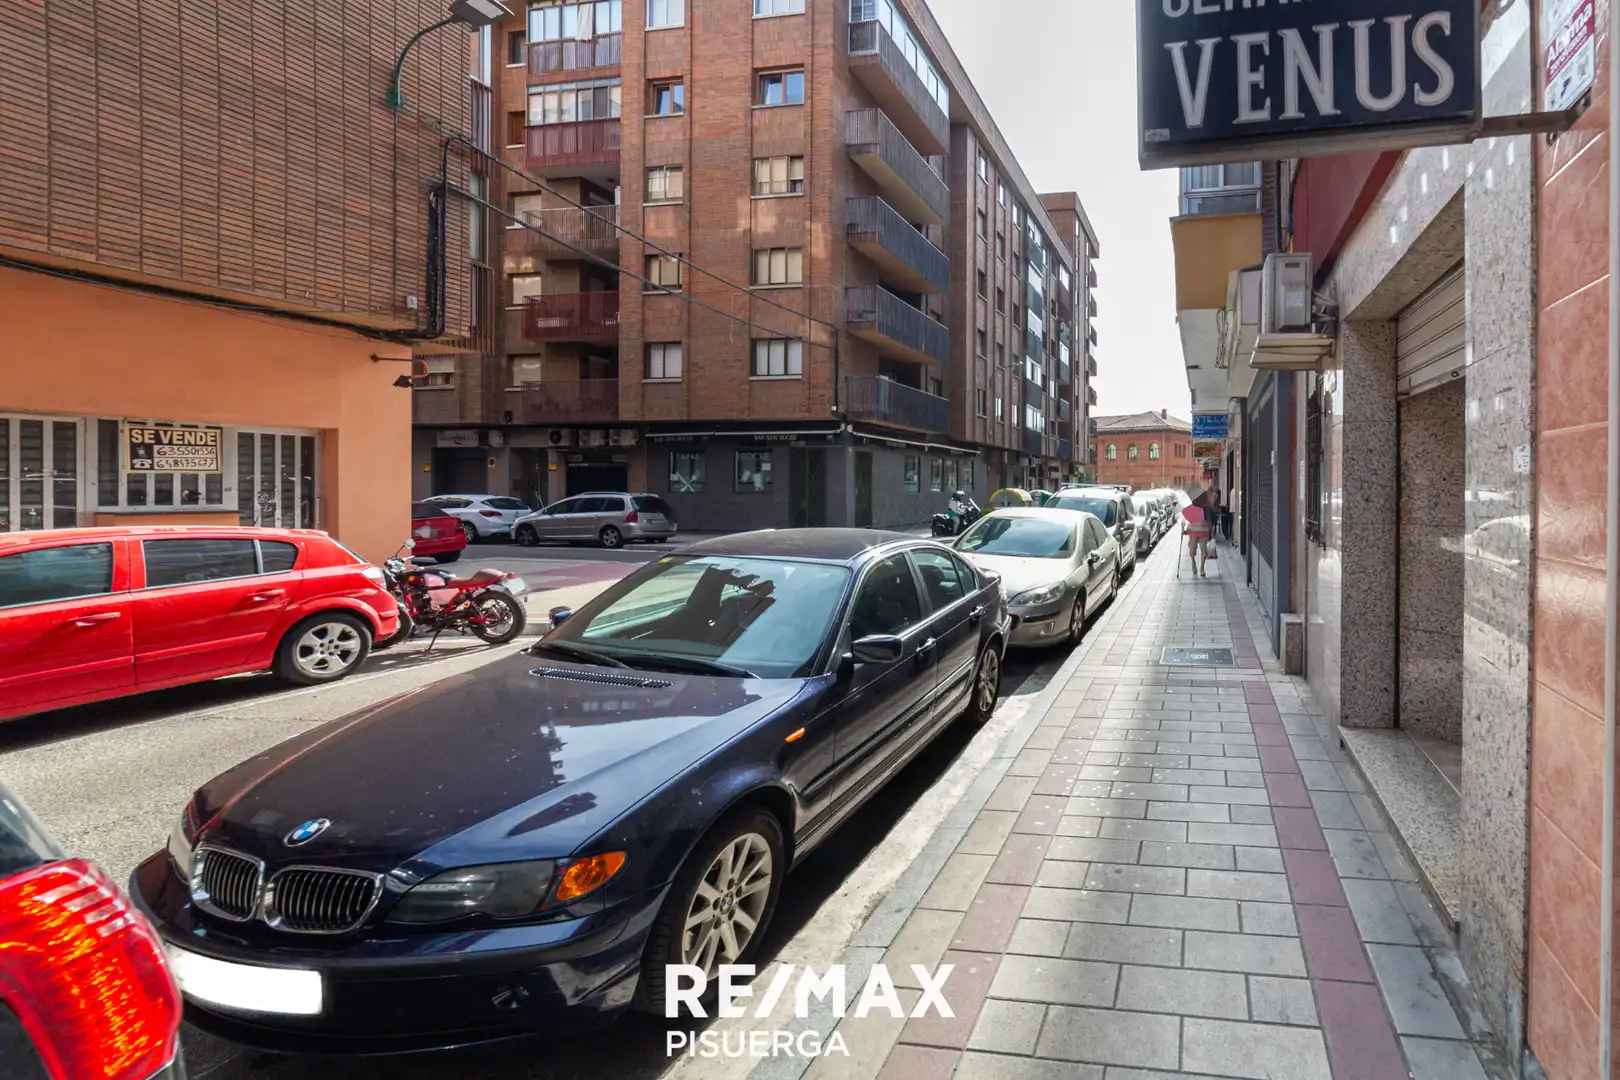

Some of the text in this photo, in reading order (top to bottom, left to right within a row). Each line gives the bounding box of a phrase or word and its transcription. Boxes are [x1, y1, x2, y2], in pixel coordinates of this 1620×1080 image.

[1163, 11, 1454, 128] VENUS
[131, 429, 216, 445] SE VENDE
